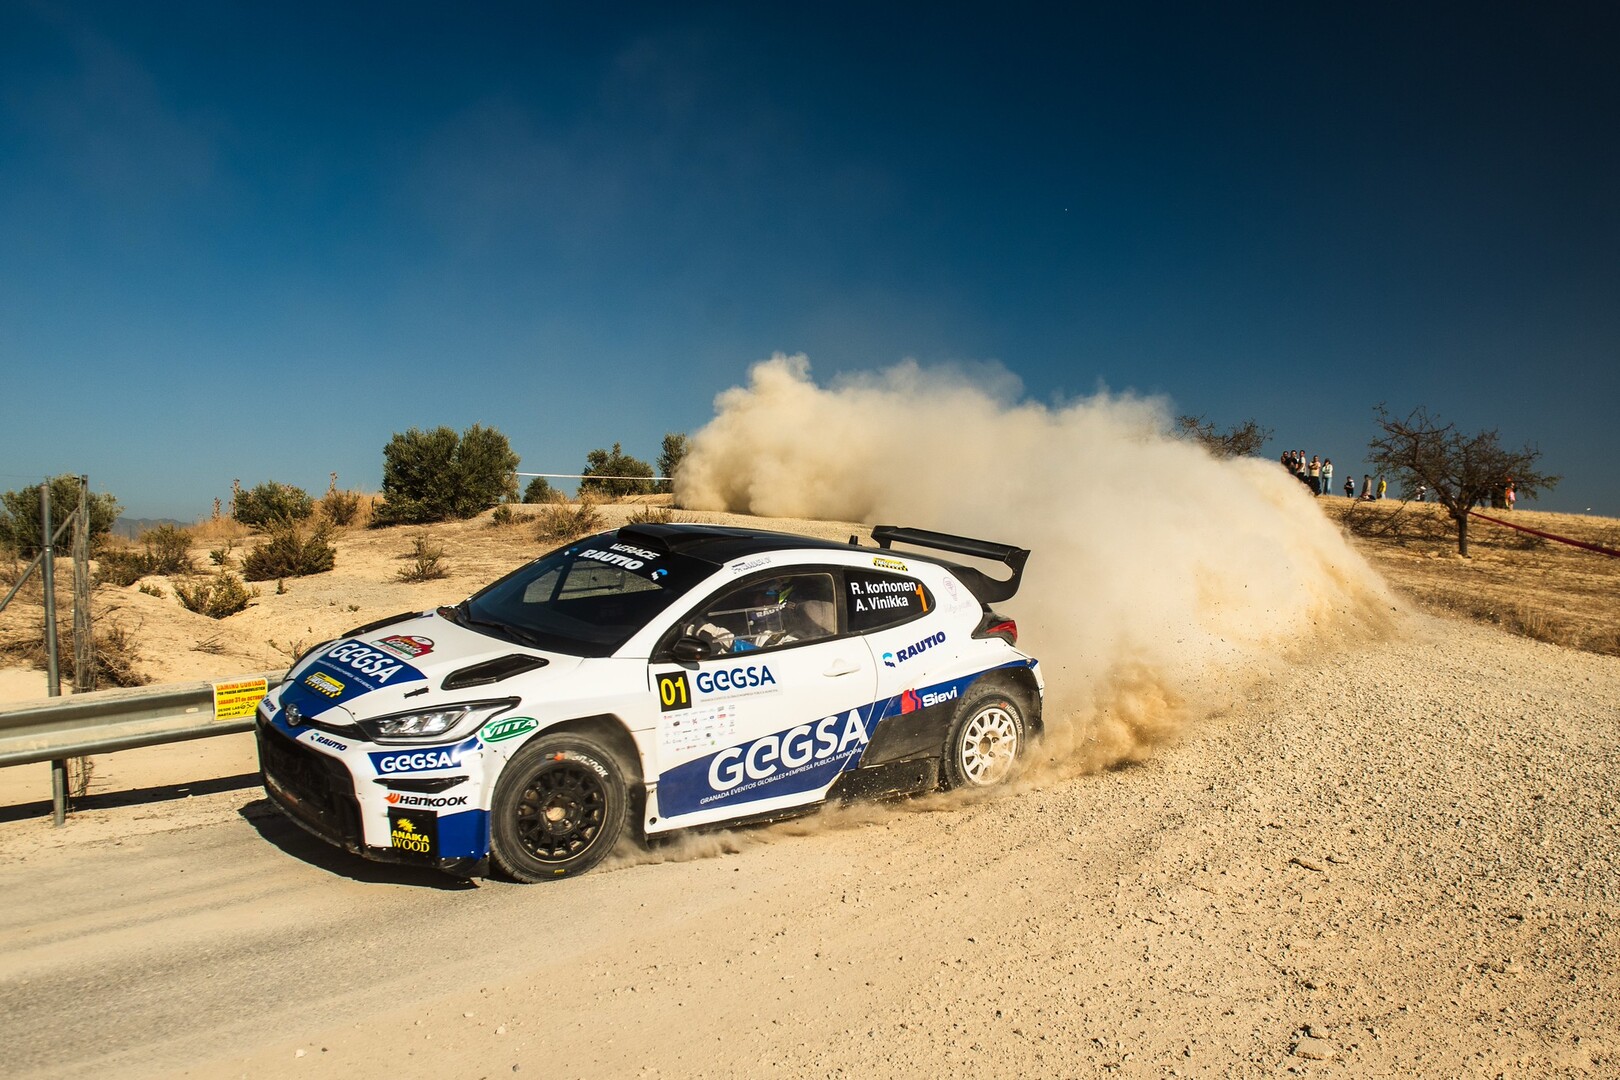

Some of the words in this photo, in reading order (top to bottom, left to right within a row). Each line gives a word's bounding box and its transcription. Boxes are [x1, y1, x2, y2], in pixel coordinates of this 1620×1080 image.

[578, 549, 644, 570] RAUTIO
[850, 582, 864, 595] R.
[865, 580, 917, 594] korhonen
[915, 583, 928, 612] 1
[856, 598, 868, 612] A.
[868, 595, 909, 610] Vinikka
[896, 631, 946, 663] RAUTIO
[217, 683, 239, 691] CAMINO
[240, 680, 265, 688] CORTADO
[660, 677, 687, 706] 01
[922, 686, 958, 707] Sievi
[482, 719, 538, 739] VIITA
[316, 736, 348, 751] RAUTIO
[700, 791, 730, 805] GRANADA
[730, 782, 757, 796] EVENTOS
[757, 772, 786, 787] GLOBALES
[391, 830, 430, 843] ANAIKA
[391, 838, 430, 853] WOOD
